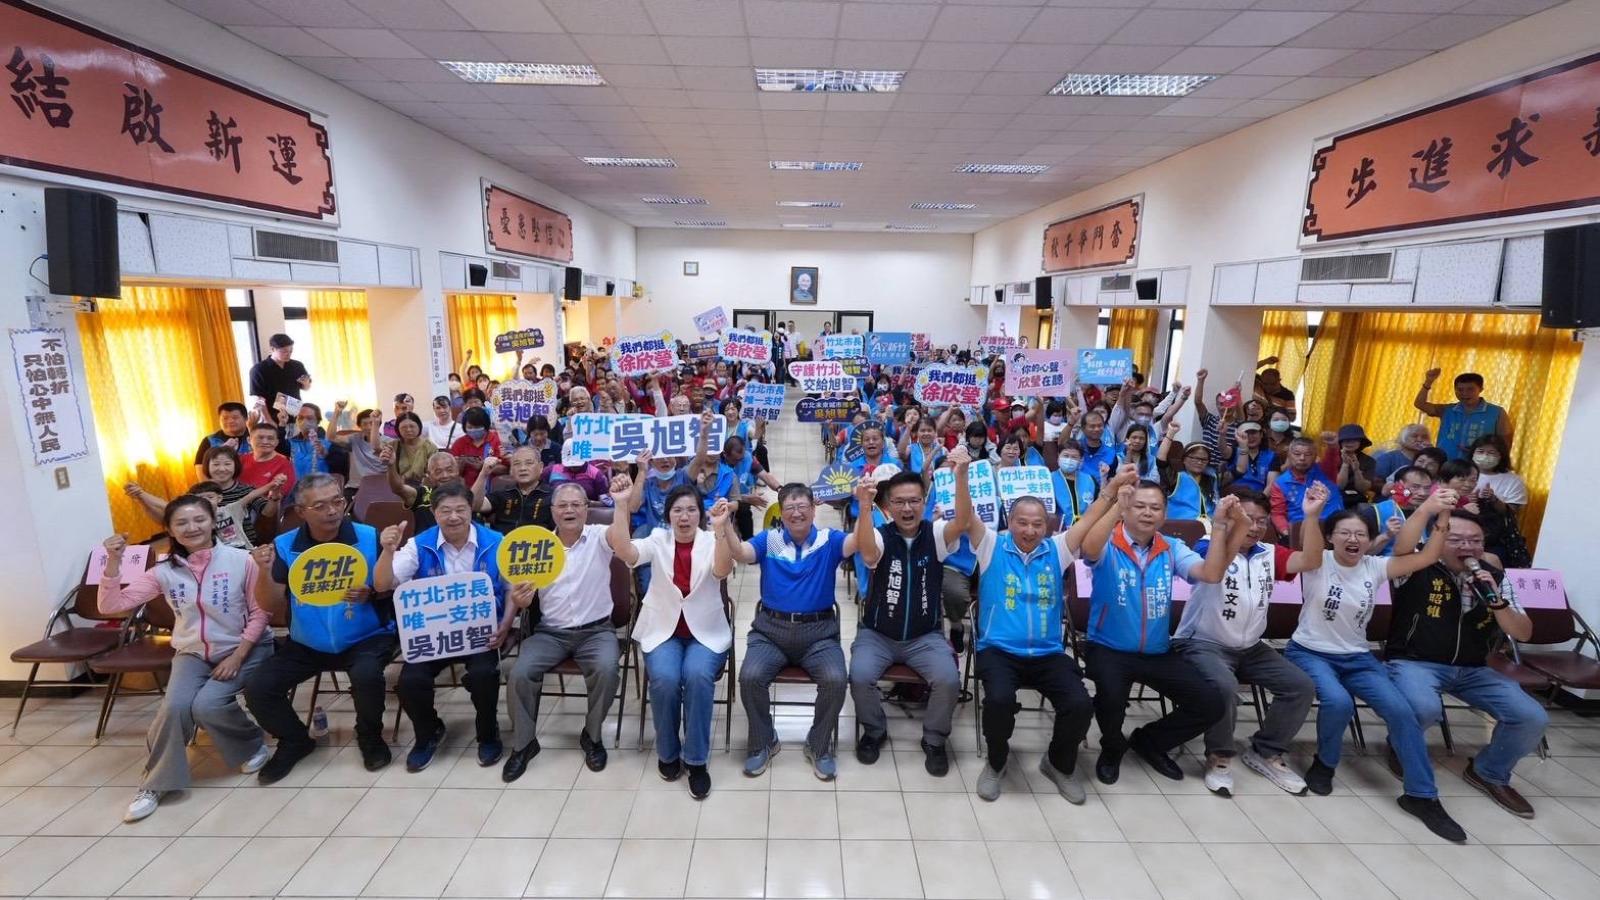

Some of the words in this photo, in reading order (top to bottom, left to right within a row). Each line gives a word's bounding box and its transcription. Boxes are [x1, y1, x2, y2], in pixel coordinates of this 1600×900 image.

[620, 340, 665, 354] 我們都挺
[728, 333, 764, 345] 我們都挺
[724, 342, 768, 360] 徐欣瑩
[41, 338, 69, 396] 不怕轉折
[617, 350, 673, 372] 徐欣瑩
[791, 363, 841, 377] 守護竹北
[1022, 361, 1059, 374] 你的心聲
[804, 378, 854, 391] 交給旭智
[929, 369, 977, 385] 我們都挺
[1018, 374, 1064, 389] 欣瑩在聽
[501, 387, 545, 402] 我們都挺
[746, 383, 784, 395] 竹北市長
[921, 382, 982, 404] 徐欣瑩
[23, 353, 61, 455] 只怕心中無人民
[498, 402, 550, 423] 吳旭智
[742, 408, 780, 420] 吳旭智
[612, 417, 723, 460] 吳旭智
[572, 440, 609, 460] 唯一
[1000, 469, 1049, 481] 竹北市長
[1002, 482, 1052, 494] 唯一支持
[508, 539, 555, 563] 竹北
[303, 556, 357, 581] 竹北
[508, 562, 553, 576] 我來扛!
[886, 559, 903, 605] 吳旭智
[1515, 577, 1557, 591] 貴賓席
[400, 578, 489, 608] 竹北市長
[1222, 577, 1239, 621] 杜文中
[402, 601, 492, 631] 唯一支持
[406, 625, 493, 659] 吳旭智
